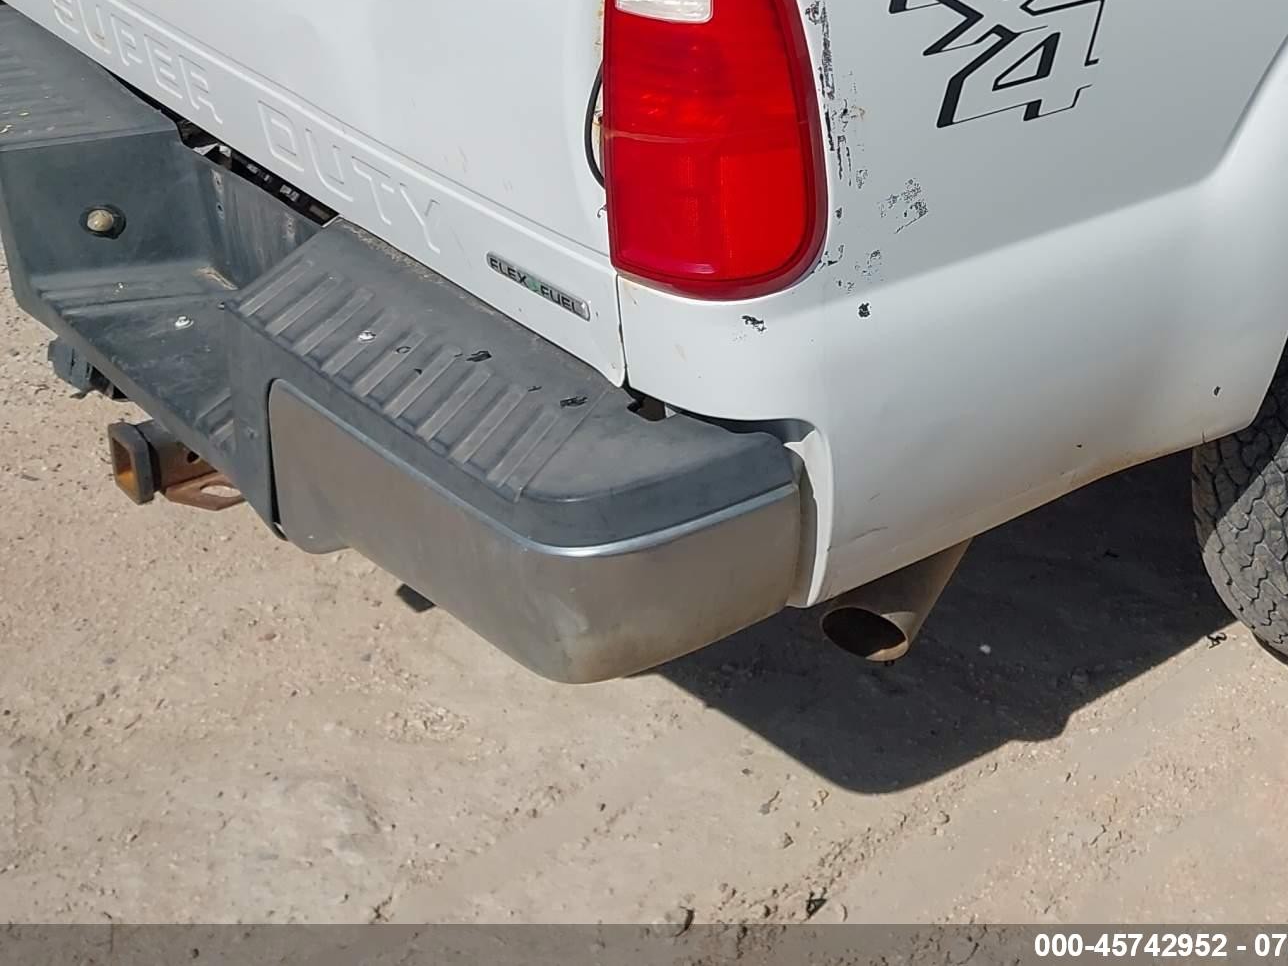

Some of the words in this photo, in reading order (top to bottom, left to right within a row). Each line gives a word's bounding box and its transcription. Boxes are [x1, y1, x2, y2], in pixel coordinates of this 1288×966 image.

[257, 100, 442, 255] DUTY
[489, 256, 530, 290] FLEX
[540, 284, 583, 317] FUEL
